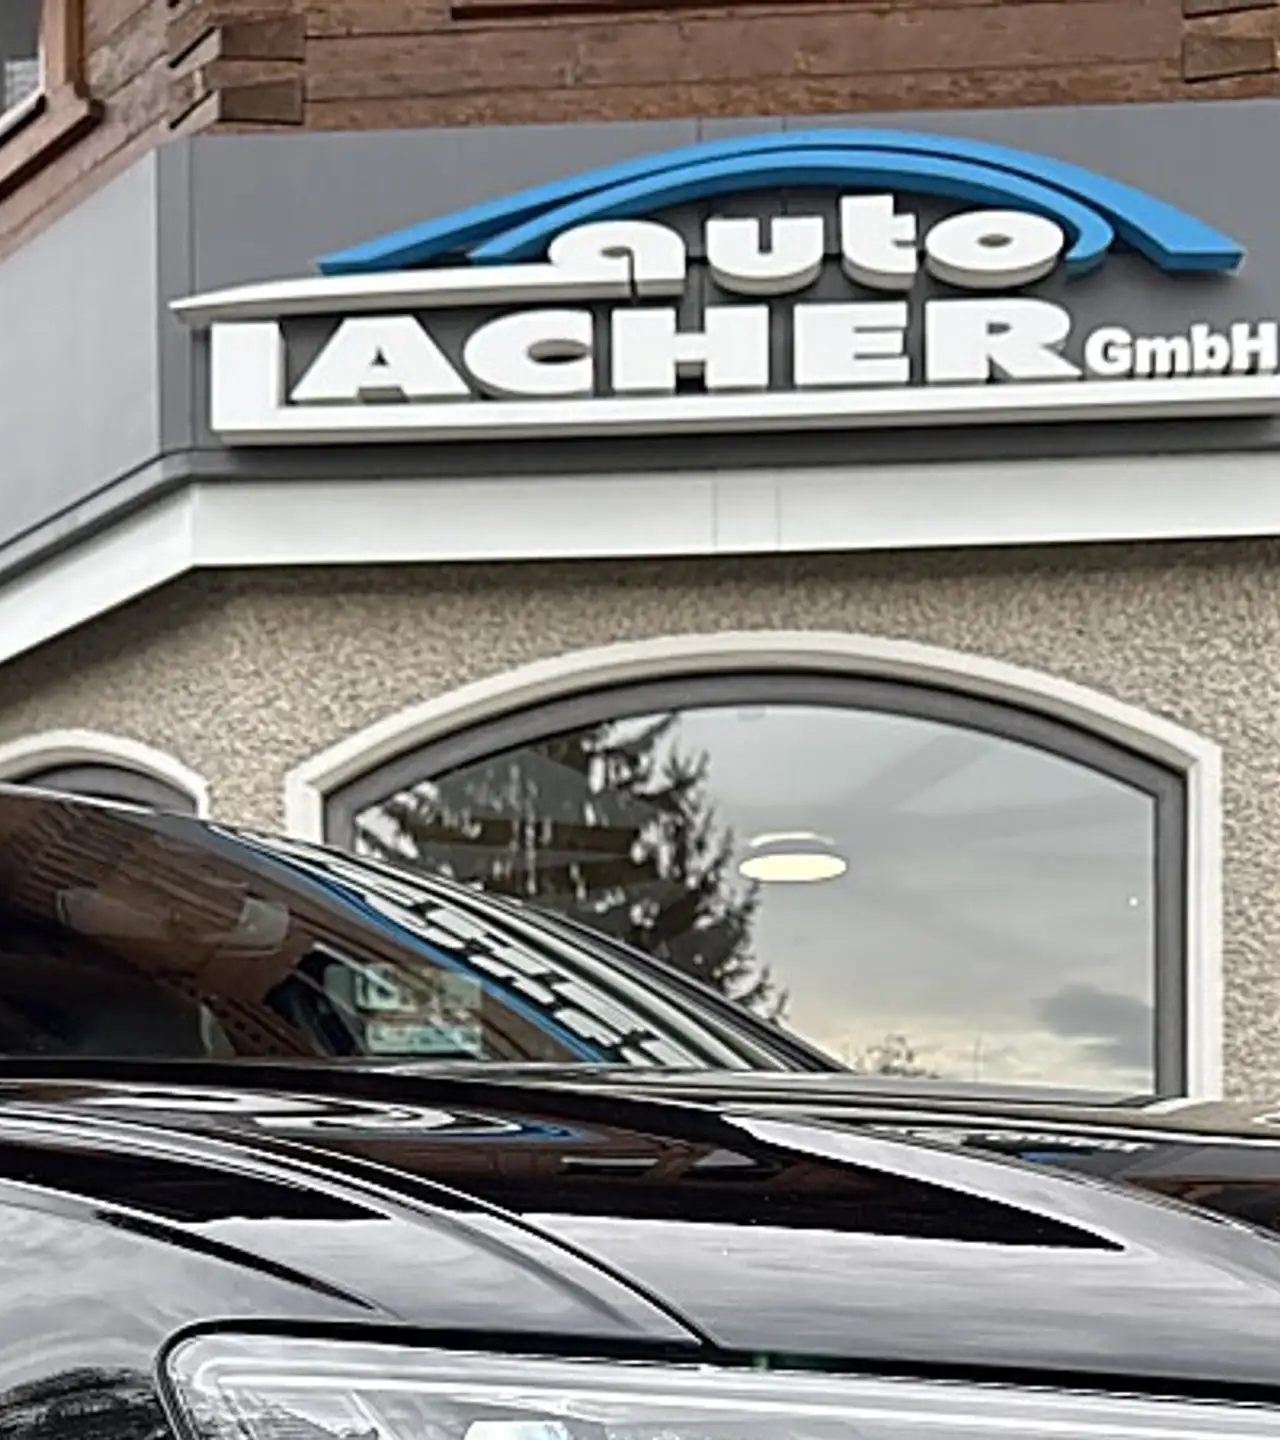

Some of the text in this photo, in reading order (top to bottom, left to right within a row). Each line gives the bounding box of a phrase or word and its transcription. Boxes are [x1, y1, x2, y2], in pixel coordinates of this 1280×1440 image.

[545, 194, 1064, 294] auto
[210, 297, 1280, 438] LACHER GmbH
